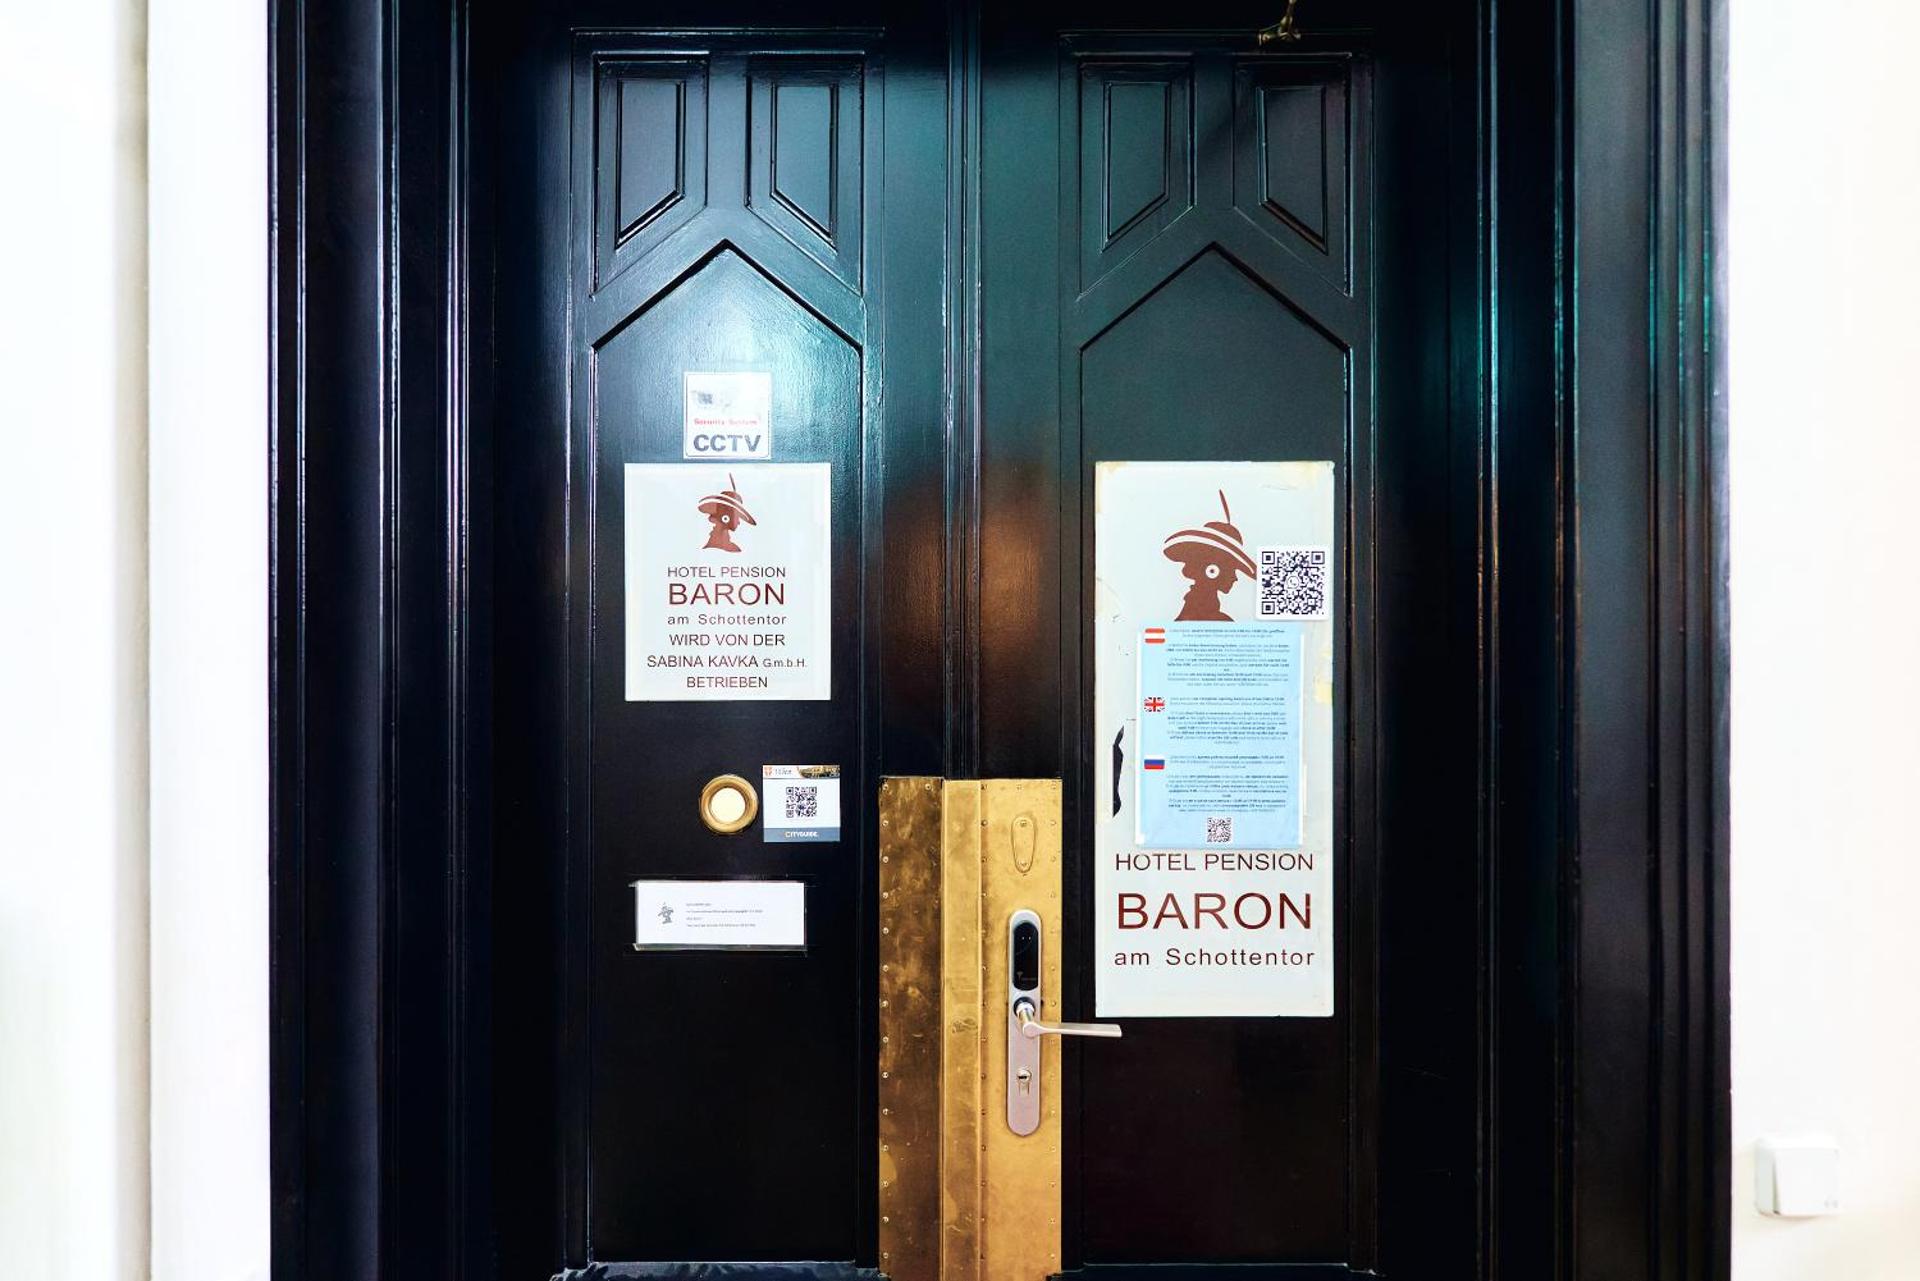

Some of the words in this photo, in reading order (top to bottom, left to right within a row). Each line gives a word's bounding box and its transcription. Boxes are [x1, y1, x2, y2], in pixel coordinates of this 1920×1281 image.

[693, 434, 761, 452] CCTV
[667, 567, 716, 578] HOTEL
[720, 567, 786, 578] PENSION
[668, 583, 785, 605] BARON
[667, 615, 690, 625] am
[698, 613, 787, 625] Schottentor
[669, 634, 710, 646] WIRD
[715, 634, 749, 646] VON
[753, 634, 785, 646] DER
[647, 655, 704, 668] SABINA
[708, 655, 759, 668] KAVKA
[686, 677, 768, 688] BETRIEBEN
[1115, 853, 1196, 871] HOTEL
[1204, 853, 1313, 871] PENSION
[1117, 893, 1312, 930] BARON
[1114, 952, 1150, 966] am
[1165, 948, 1315, 966] Schottentor
